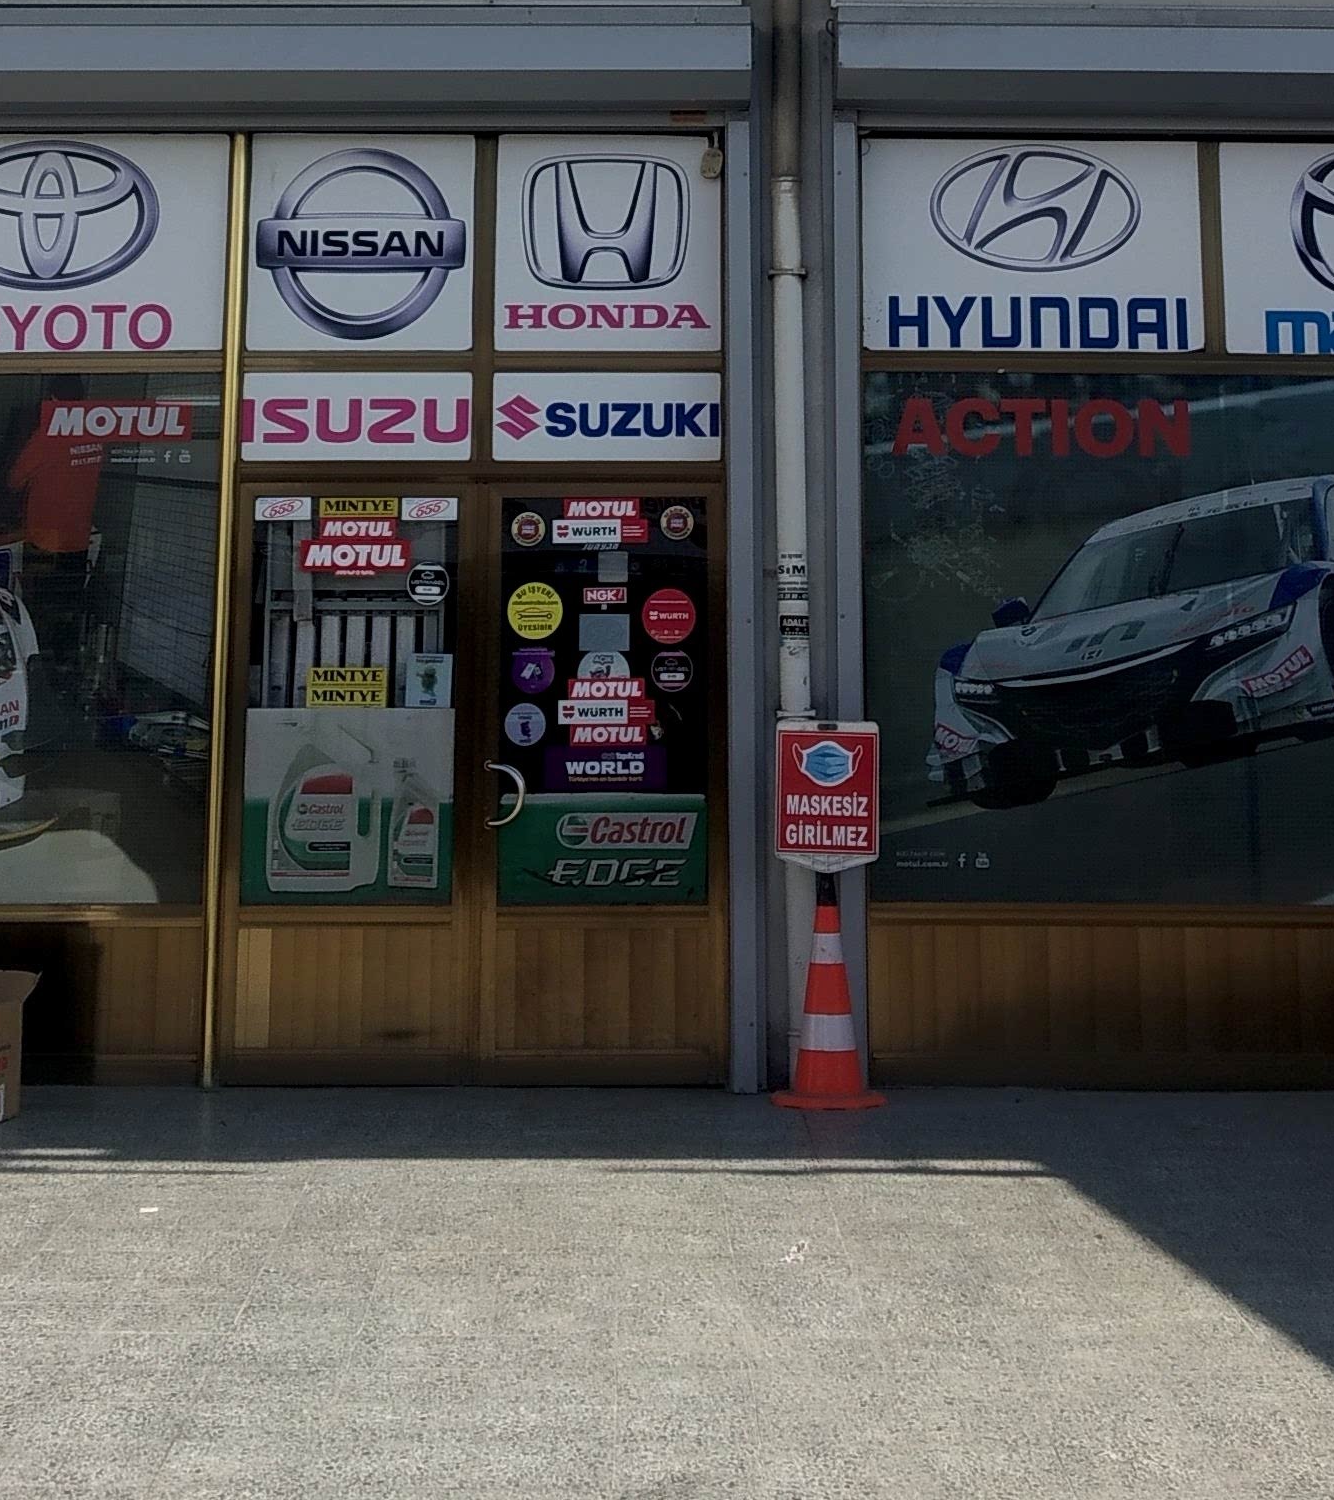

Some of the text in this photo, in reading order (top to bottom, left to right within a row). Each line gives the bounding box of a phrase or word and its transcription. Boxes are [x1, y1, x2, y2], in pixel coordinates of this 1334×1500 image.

[277, 227, 447, 260] NISSAN
[504, 304, 712, 330] HONDA
[888, 297, 1188, 350] HYUNDAI
[47, 406, 187, 437] MOTUL
[241, 398, 470, 444] ISUZU
[545, 402, 720, 438] SUZUKI
[891, 397, 1192, 458] ACTION
[324, 500, 394, 512] MINTYE
[567, 501, 638, 517] MOTUL
[322, 520, 394, 537] MOTUL
[572, 525, 617, 537] WÜRTH
[303, 544, 407, 567] MOTUL
[586, 589, 617, 601] NGK
[311, 670, 383, 682] MINTYE
[1247, 650, 1313, 692] MOTUL
[311, 690, 382, 702] MINTYE
[571, 681, 642, 698] MOTUL
[578, 707, 624, 717] WÜRTH
[573, 726, 644, 743] MOTUL
[565, 761, 645, 775] WORLD
[308, 803, 345, 814] Castrol
[786, 791, 869, 817] MASKESİZ
[590, 817, 687, 844] Castrol
[785, 820, 868, 847] GİRİLMEZ
[547, 859, 688, 887] EDGE
[896, 860, 949, 868] motul.com.tr
